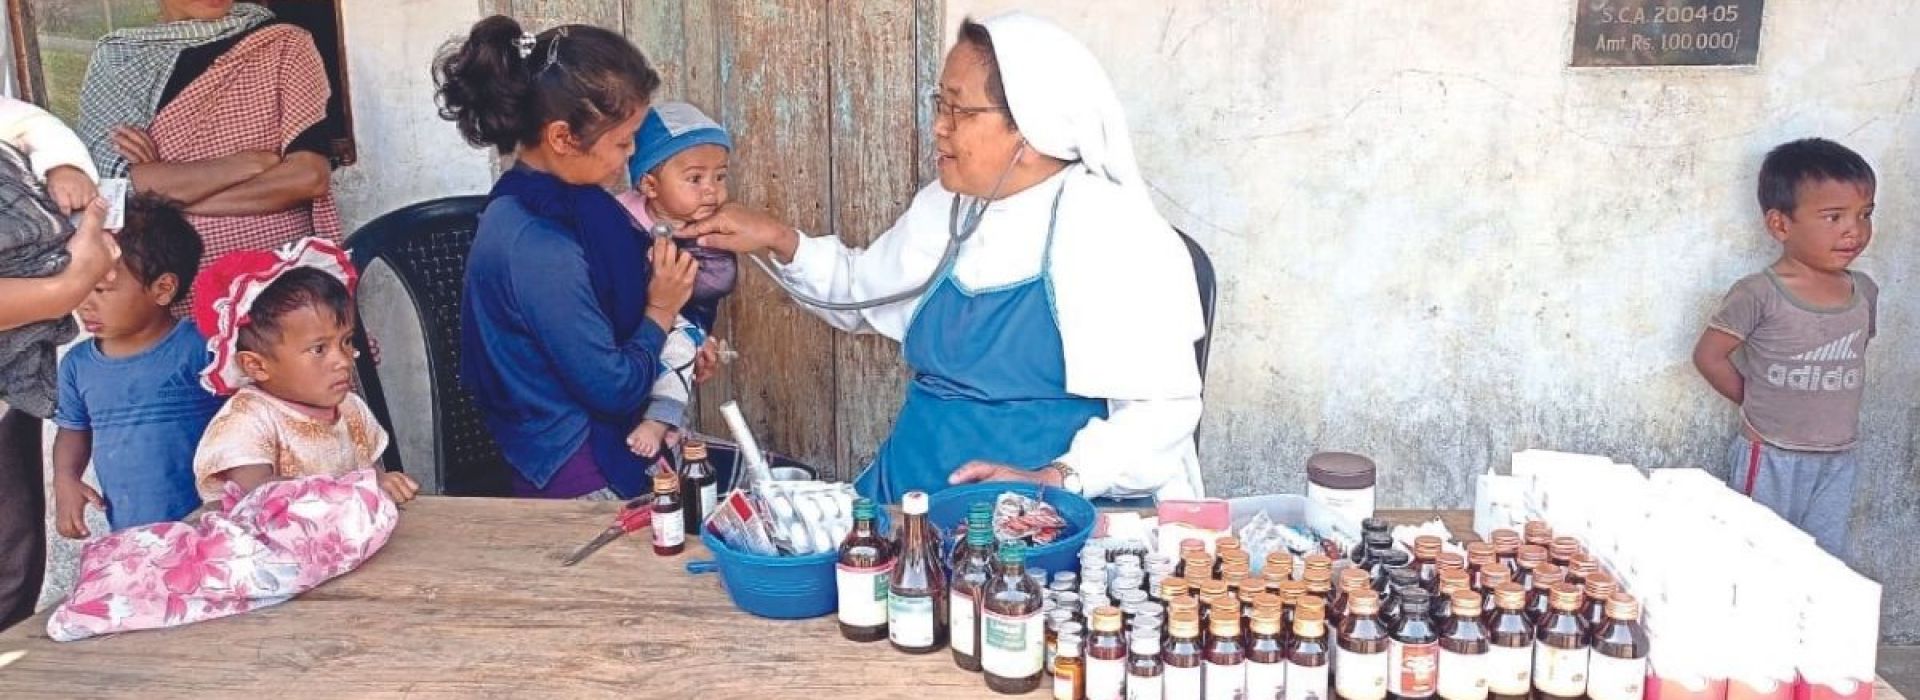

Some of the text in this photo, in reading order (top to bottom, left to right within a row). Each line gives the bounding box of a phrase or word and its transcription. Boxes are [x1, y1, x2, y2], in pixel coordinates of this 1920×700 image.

[1654, 4, 1739, 23] 2004-05
[1631, 34, 1656, 51] Rs.
[1767, 363, 1859, 391] adida
